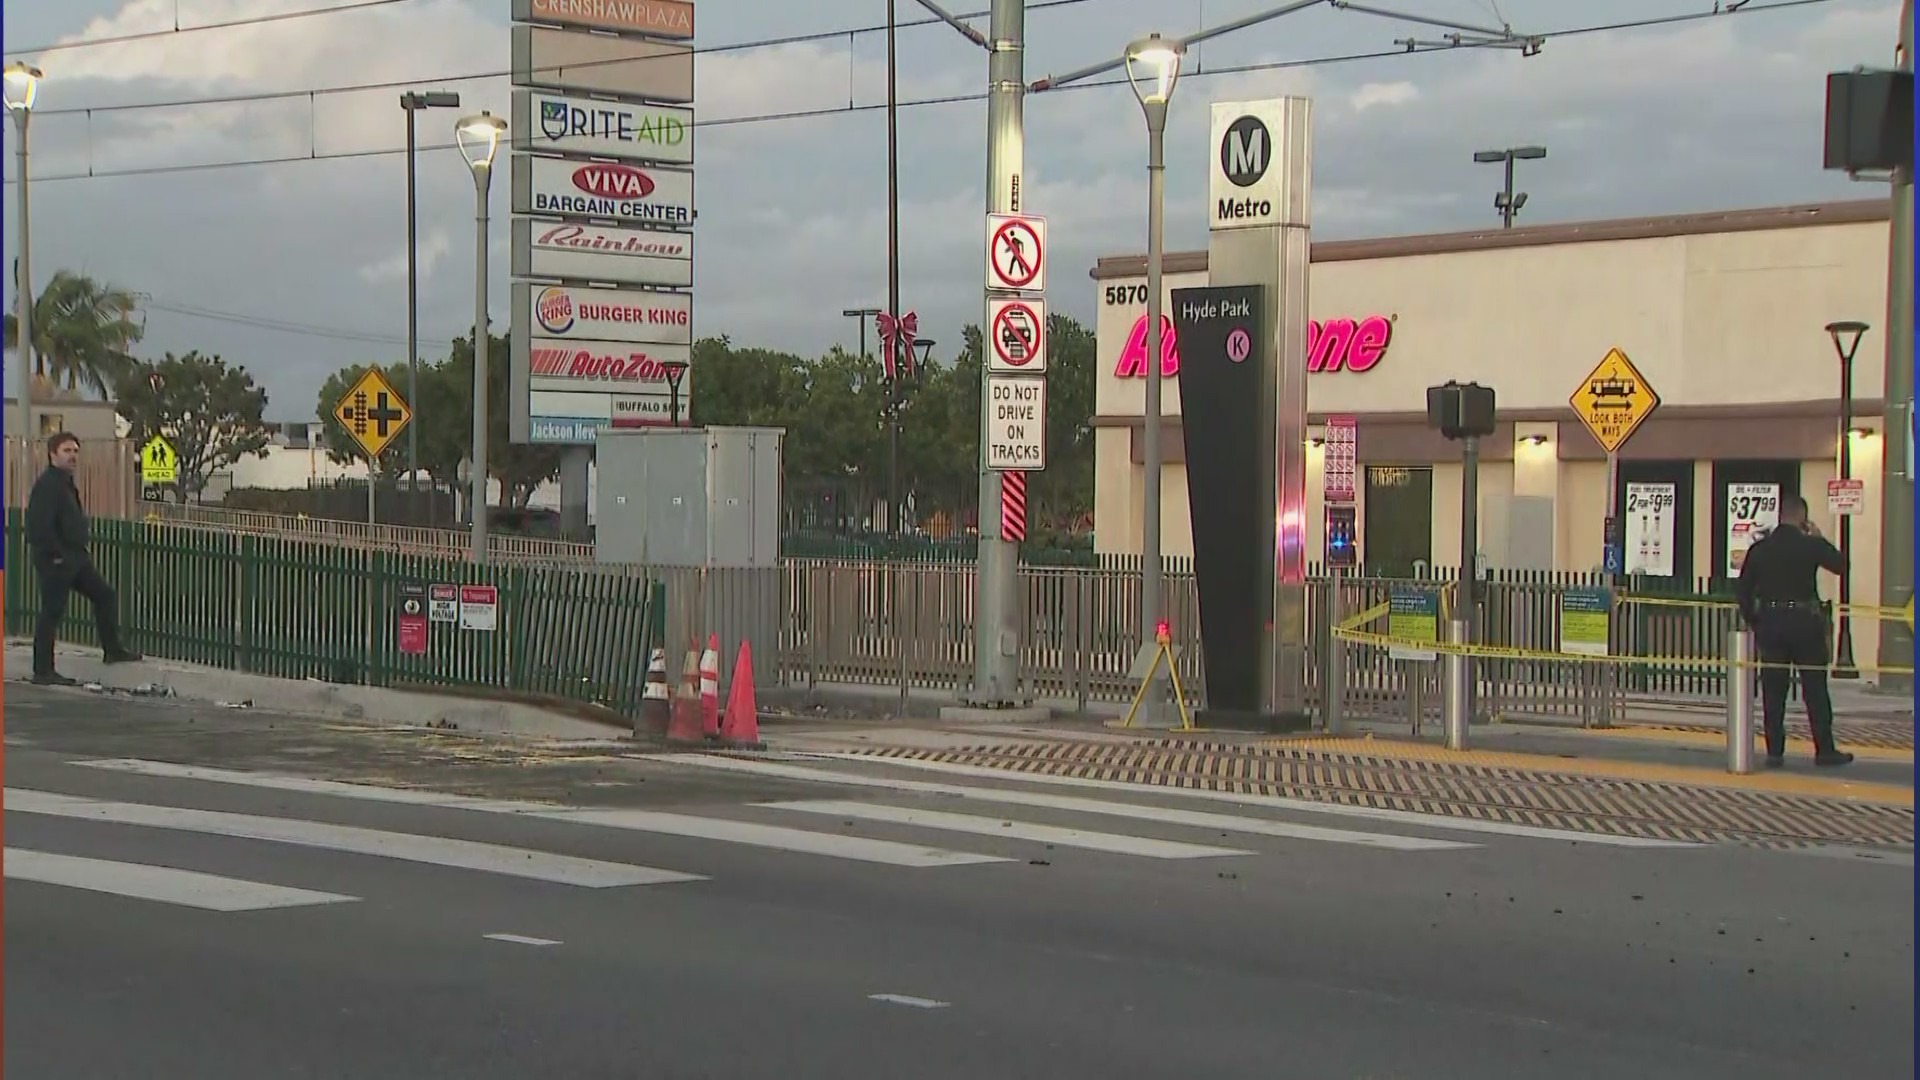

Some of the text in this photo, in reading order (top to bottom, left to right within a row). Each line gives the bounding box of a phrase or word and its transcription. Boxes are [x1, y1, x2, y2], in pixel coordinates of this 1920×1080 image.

[571, 107, 684, 145] RITE AID
[1229, 128, 1262, 175] M
[584, 170, 643, 195] VIVA
[536, 194, 688, 220] BARGAIN CENTER
[1218, 197, 1271, 219] Metro
[538, 225, 683, 255] Rainbow
[1105, 285, 1148, 305] 5870
[542, 305, 572, 321] KING
[579, 304, 687, 326] BURGER KING
[1182, 297, 1250, 324] Hyde Park
[1233, 336, 1244, 356] K
[994, 384, 1039, 400] DO NOT
[619, 401, 660, 412] BUFFALO
[663, 403, 686, 413] ST
[998, 405, 1034, 420] DRIVE
[1590, 413, 1633, 424] LOOK BOTH
[532, 422, 573, 440] Jackson
[1007, 425, 1024, 440] ON
[1602, 426, 1620, 437] WAYS
[992, 444, 1039, 460] TRACKS
[1628, 494, 1638, 512] 2
[1637, 499, 1648, 508] FOR
[431, 609, 455, 620] VOLTAGE
